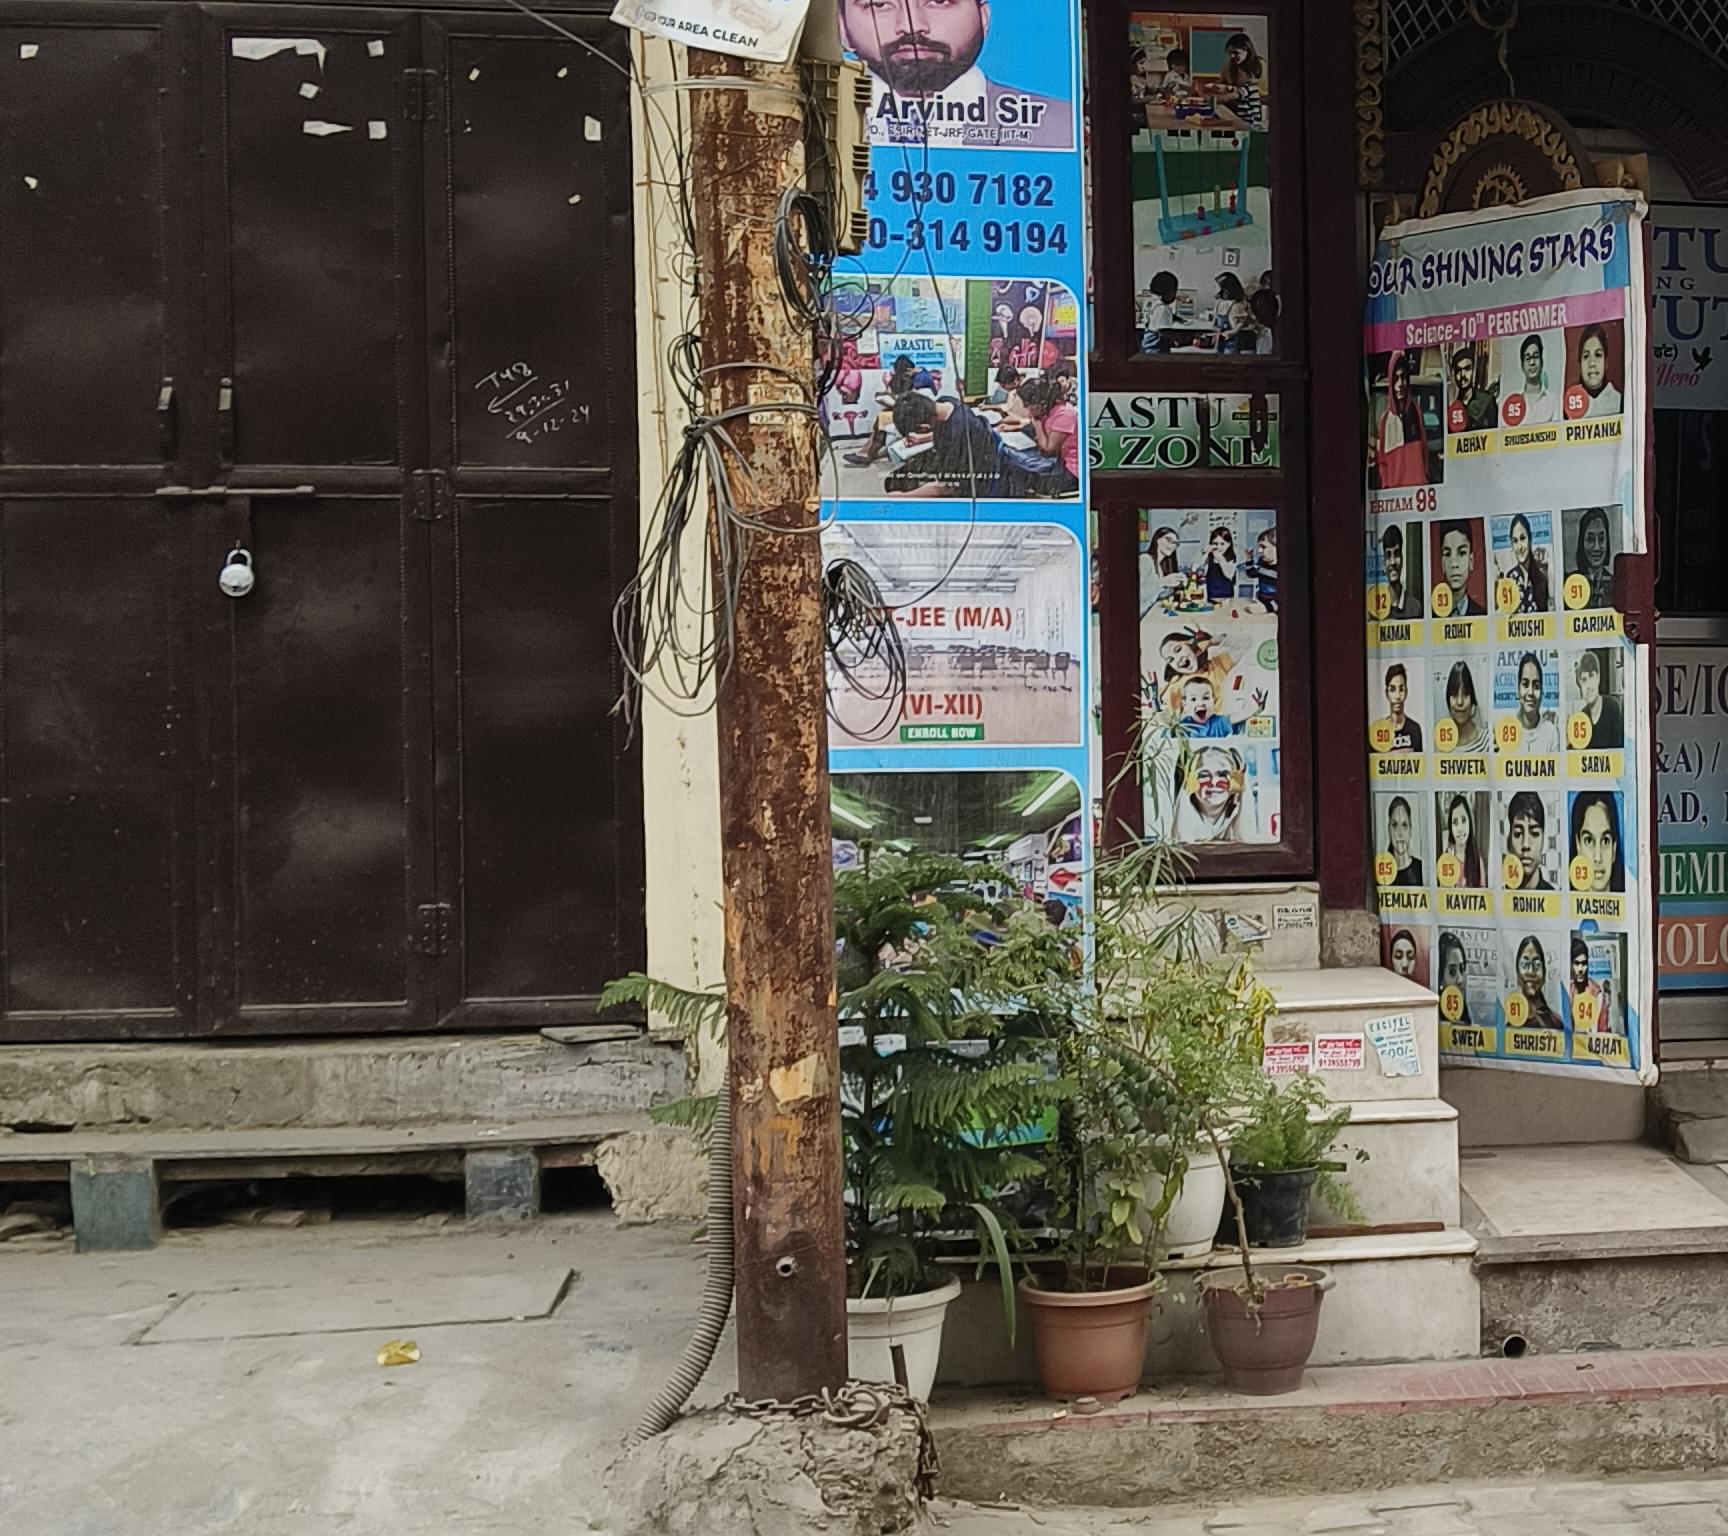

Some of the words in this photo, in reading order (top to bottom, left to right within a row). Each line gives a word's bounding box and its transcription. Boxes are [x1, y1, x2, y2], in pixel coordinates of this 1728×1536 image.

[678, 20, 709, 37] AREA
[712, 28, 760, 49] CLEAN
[876, 93, 986, 124] Arvind
[997, 93, 1045, 125] Sir
[968, 128, 997, 139] GATE
[890, 171, 956, 204] 930
[967, 173, 1054, 207] 7182
[982, 219, 1069, 254] 9194
[1421, 242, 1524, 290] SHINING
[1529, 224, 1616, 273] STARS
[1487, 302, 1568, 336] PERFORMER
[1566, 420, 1622, 441] PRIYANKA
[1415, 487, 1437, 513] 98
[955, 606, 1013, 632] (M/A)
[1508, 619, 1545, 638] KHUSHI
[1573, 615, 1615, 633] GARIMA
[1444, 622, 1473, 640] ROHIT
[908, 726, 949, 740] ENROLL
[951, 726, 977, 739] NOW
[1440, 758, 1487, 776] SHWETA
[1505, 759, 1556, 778] GUNJAN
